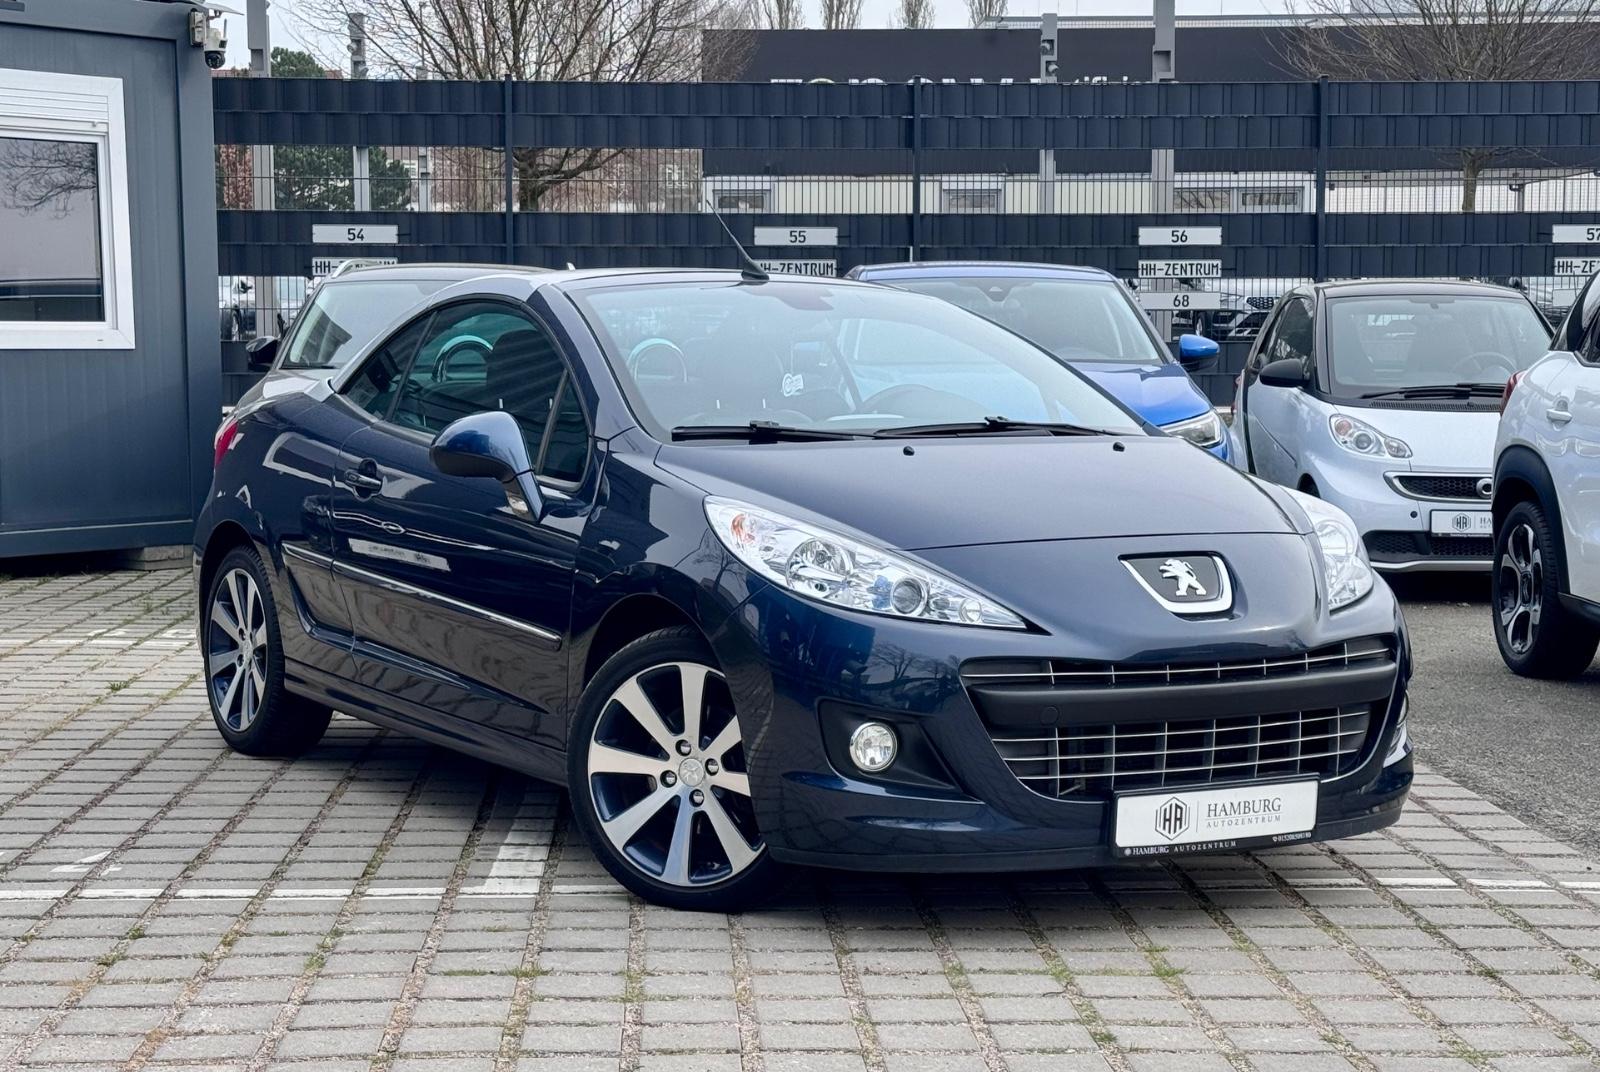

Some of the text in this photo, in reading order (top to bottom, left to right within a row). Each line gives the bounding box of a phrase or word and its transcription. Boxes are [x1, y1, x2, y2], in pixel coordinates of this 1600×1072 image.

[347, 228, 365, 241] 54
[789, 230, 807, 243] 55
[1171, 230, 1188, 243] 56
[760, 262, 834, 276] H-ZENTRUM
[1141, 263, 1219, 276] HH-ZENTRUM
[1173, 294, 1190, 308] 68
[1207, 797, 1282, 818] HAMBURG
[1206, 814, 1281, 829] AUTOZENTRUM
[1132, 840, 1237, 856] HAMBURG AUTOZENTRUM
